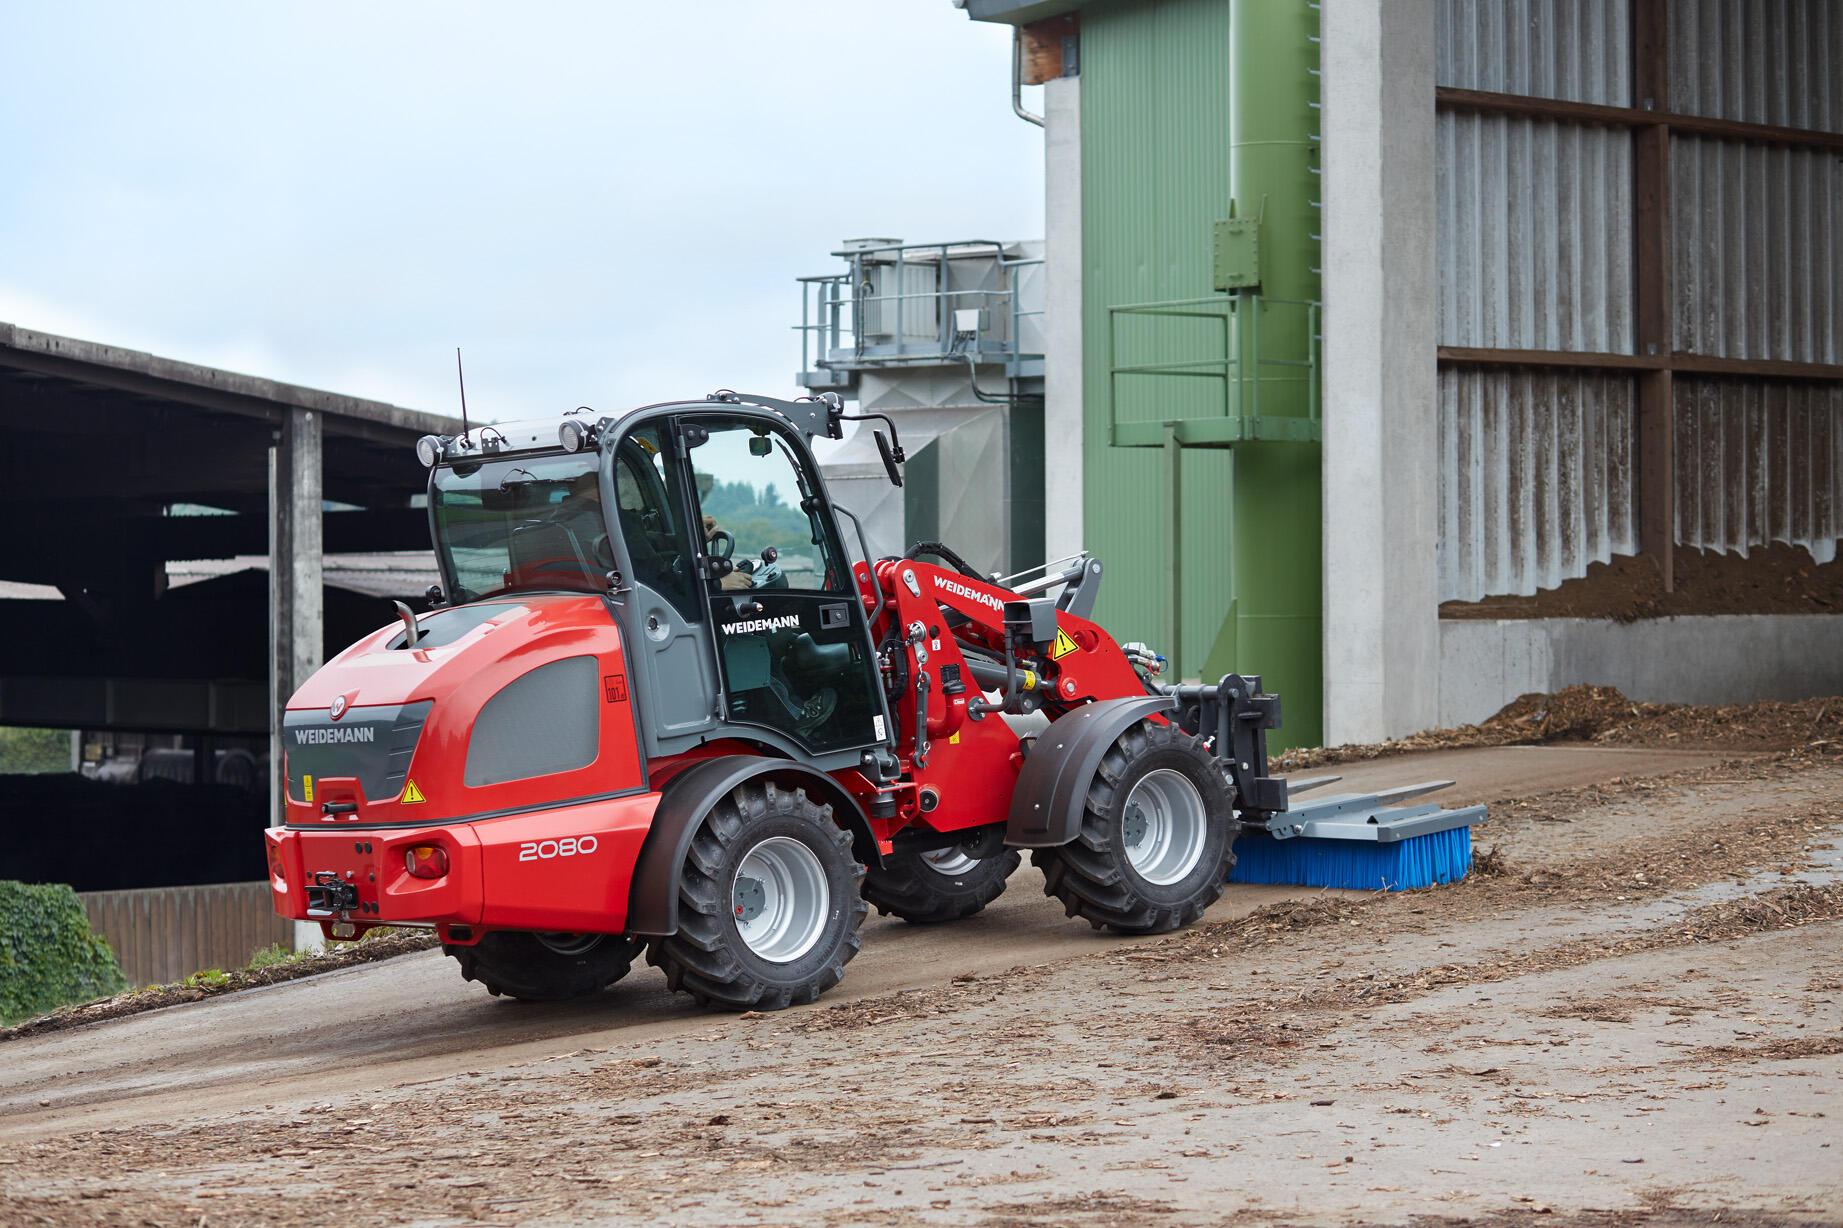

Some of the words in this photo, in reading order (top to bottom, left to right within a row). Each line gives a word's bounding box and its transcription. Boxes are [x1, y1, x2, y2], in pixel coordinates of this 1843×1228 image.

[721, 614, 800, 635] WEIDEMANN
[295, 727, 374, 745] WEIDEMANN
[519, 836, 598, 862] 2080
